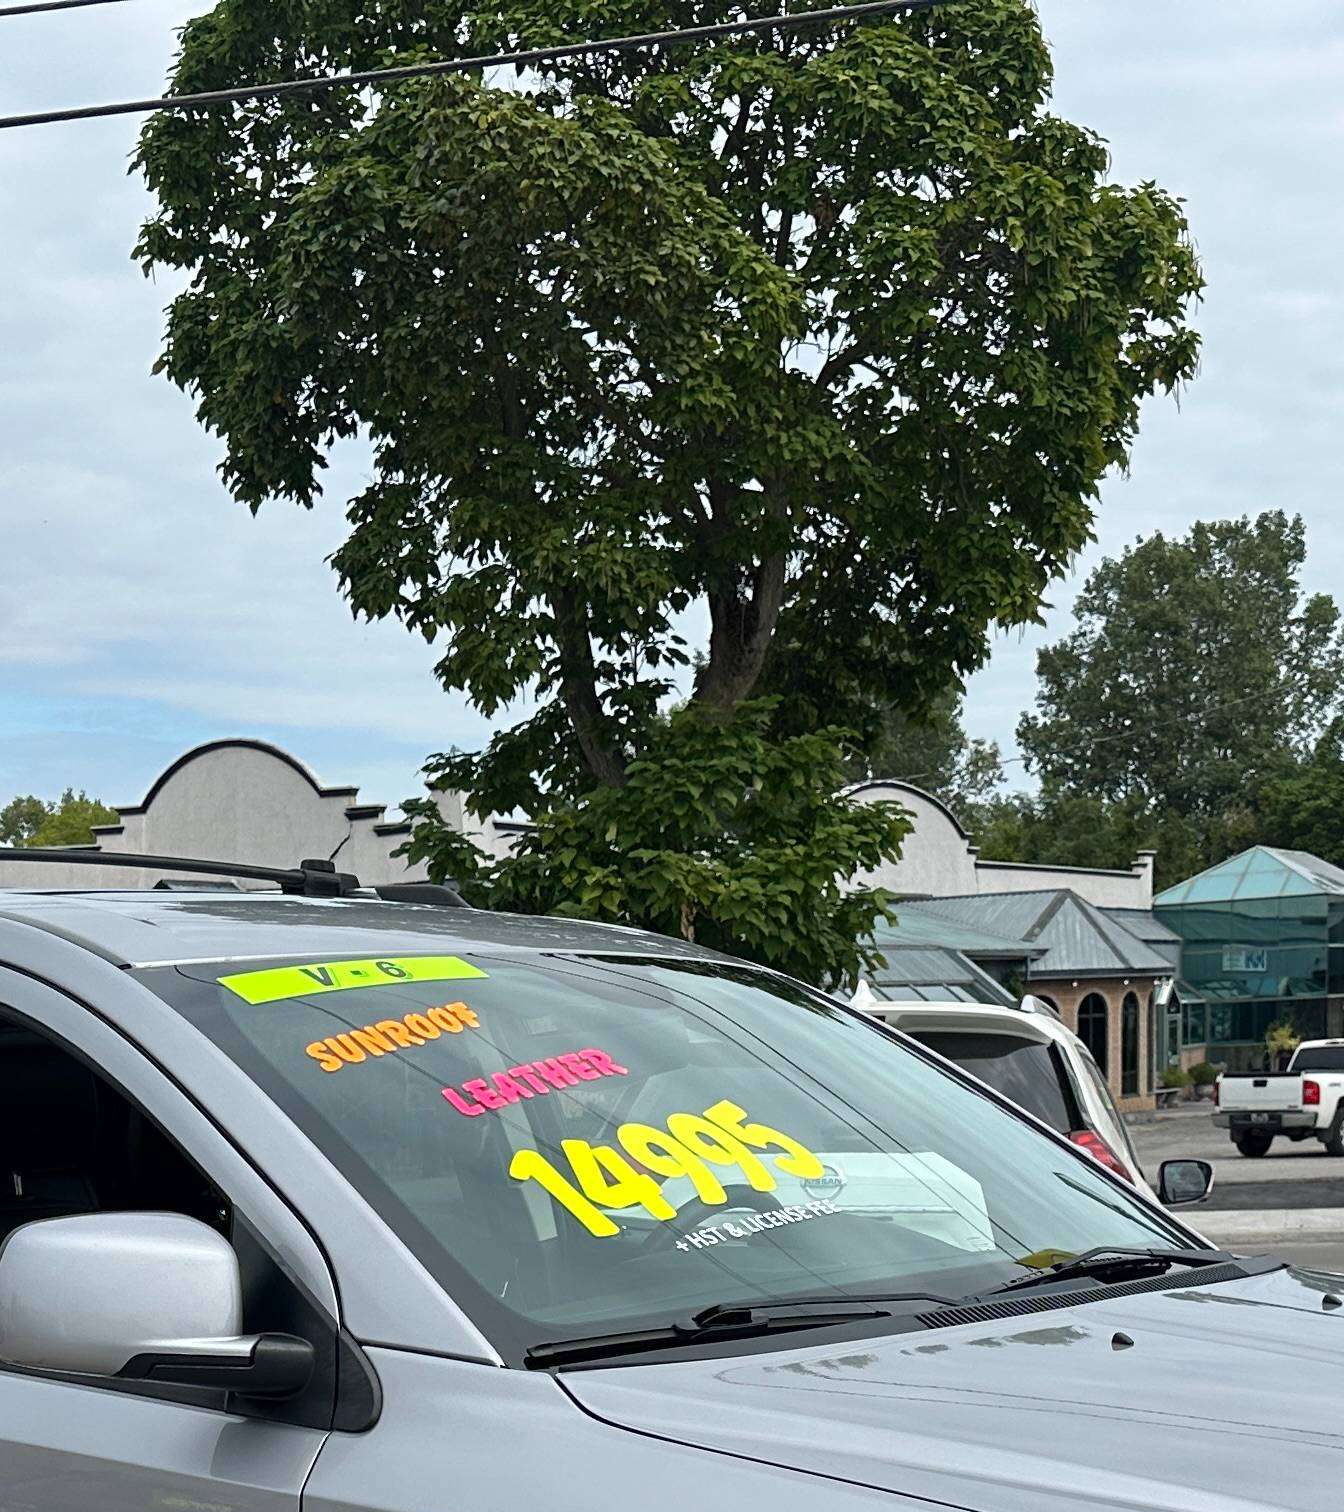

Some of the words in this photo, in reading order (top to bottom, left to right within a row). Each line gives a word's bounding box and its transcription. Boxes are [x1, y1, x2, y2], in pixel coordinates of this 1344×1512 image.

[299, 967, 334, 986] V
[375, 961, 406, 978] 6
[306, 1002, 481, 1072] SUNROOF
[442, 1048, 628, 1117] LEATHER
[509, 1099, 825, 1237] 14995
[685, 1226, 727, 1249] HST
[723, 1222, 748, 1238] &
[740, 1205, 813, 1233] LICENSE
[807, 1199, 843, 1217] FEE
